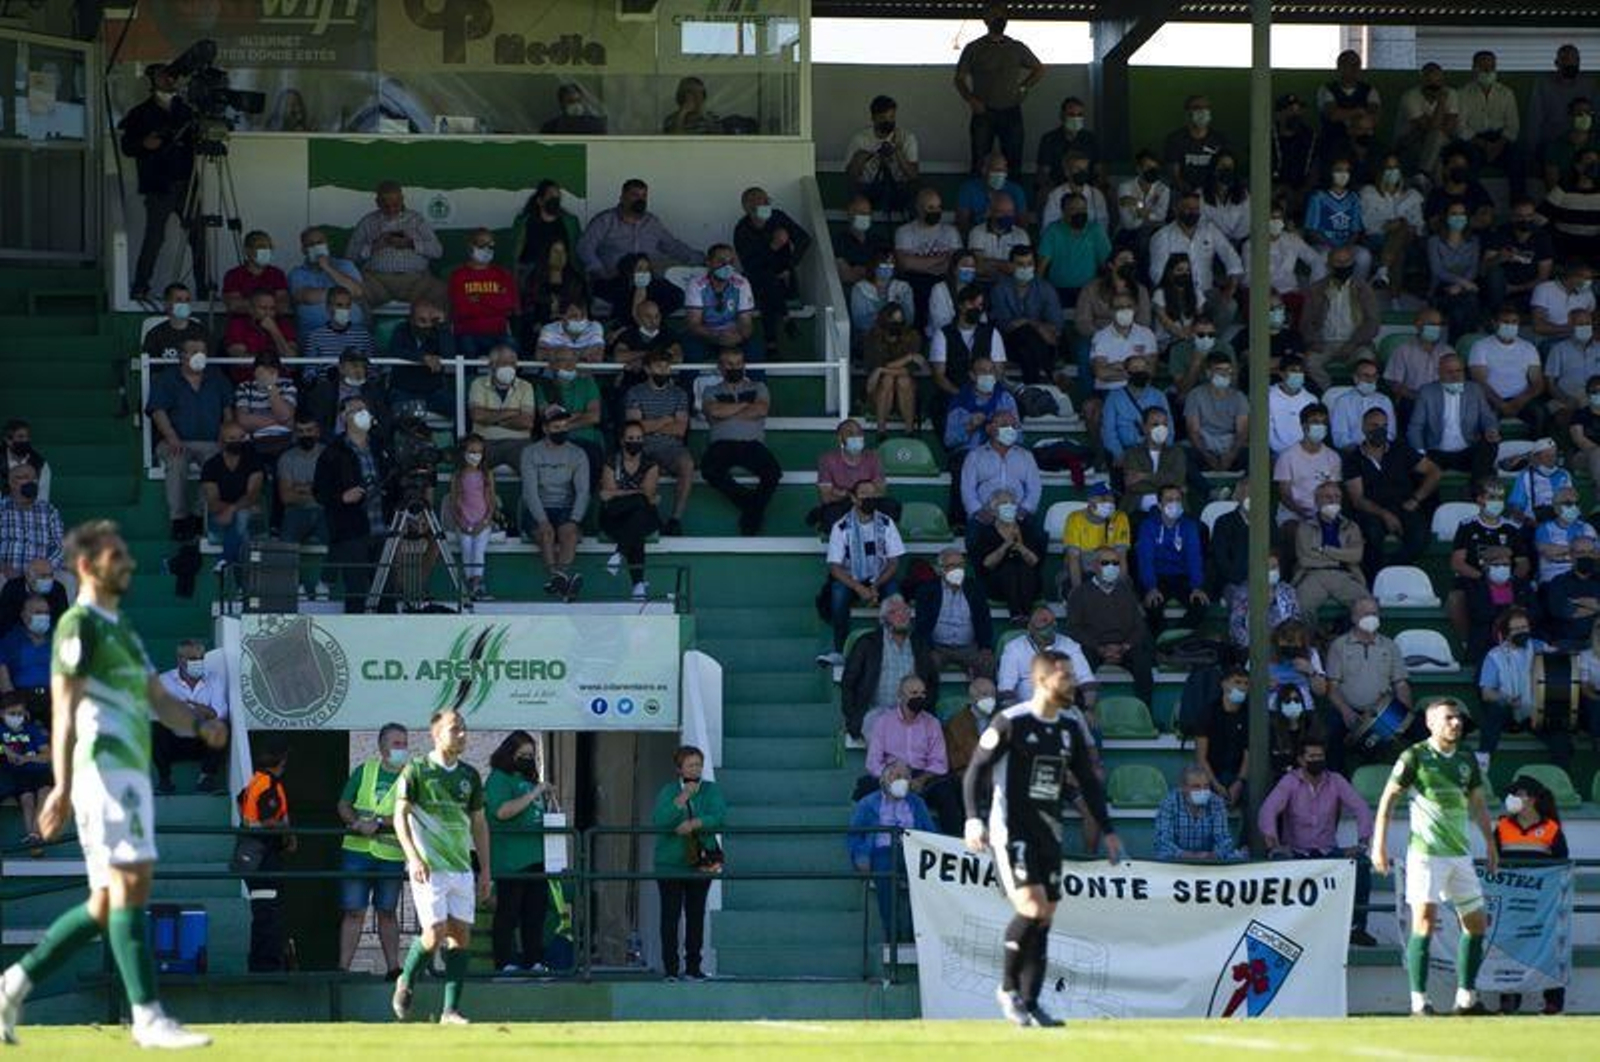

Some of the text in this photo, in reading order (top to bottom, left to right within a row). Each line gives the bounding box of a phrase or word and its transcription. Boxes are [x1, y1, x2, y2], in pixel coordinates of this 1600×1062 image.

[361, 659, 567, 681] C.D. ARENTEIRO
[918, 849, 1001, 888] PEÑA
[1063, 874, 1149, 901] ONTE
